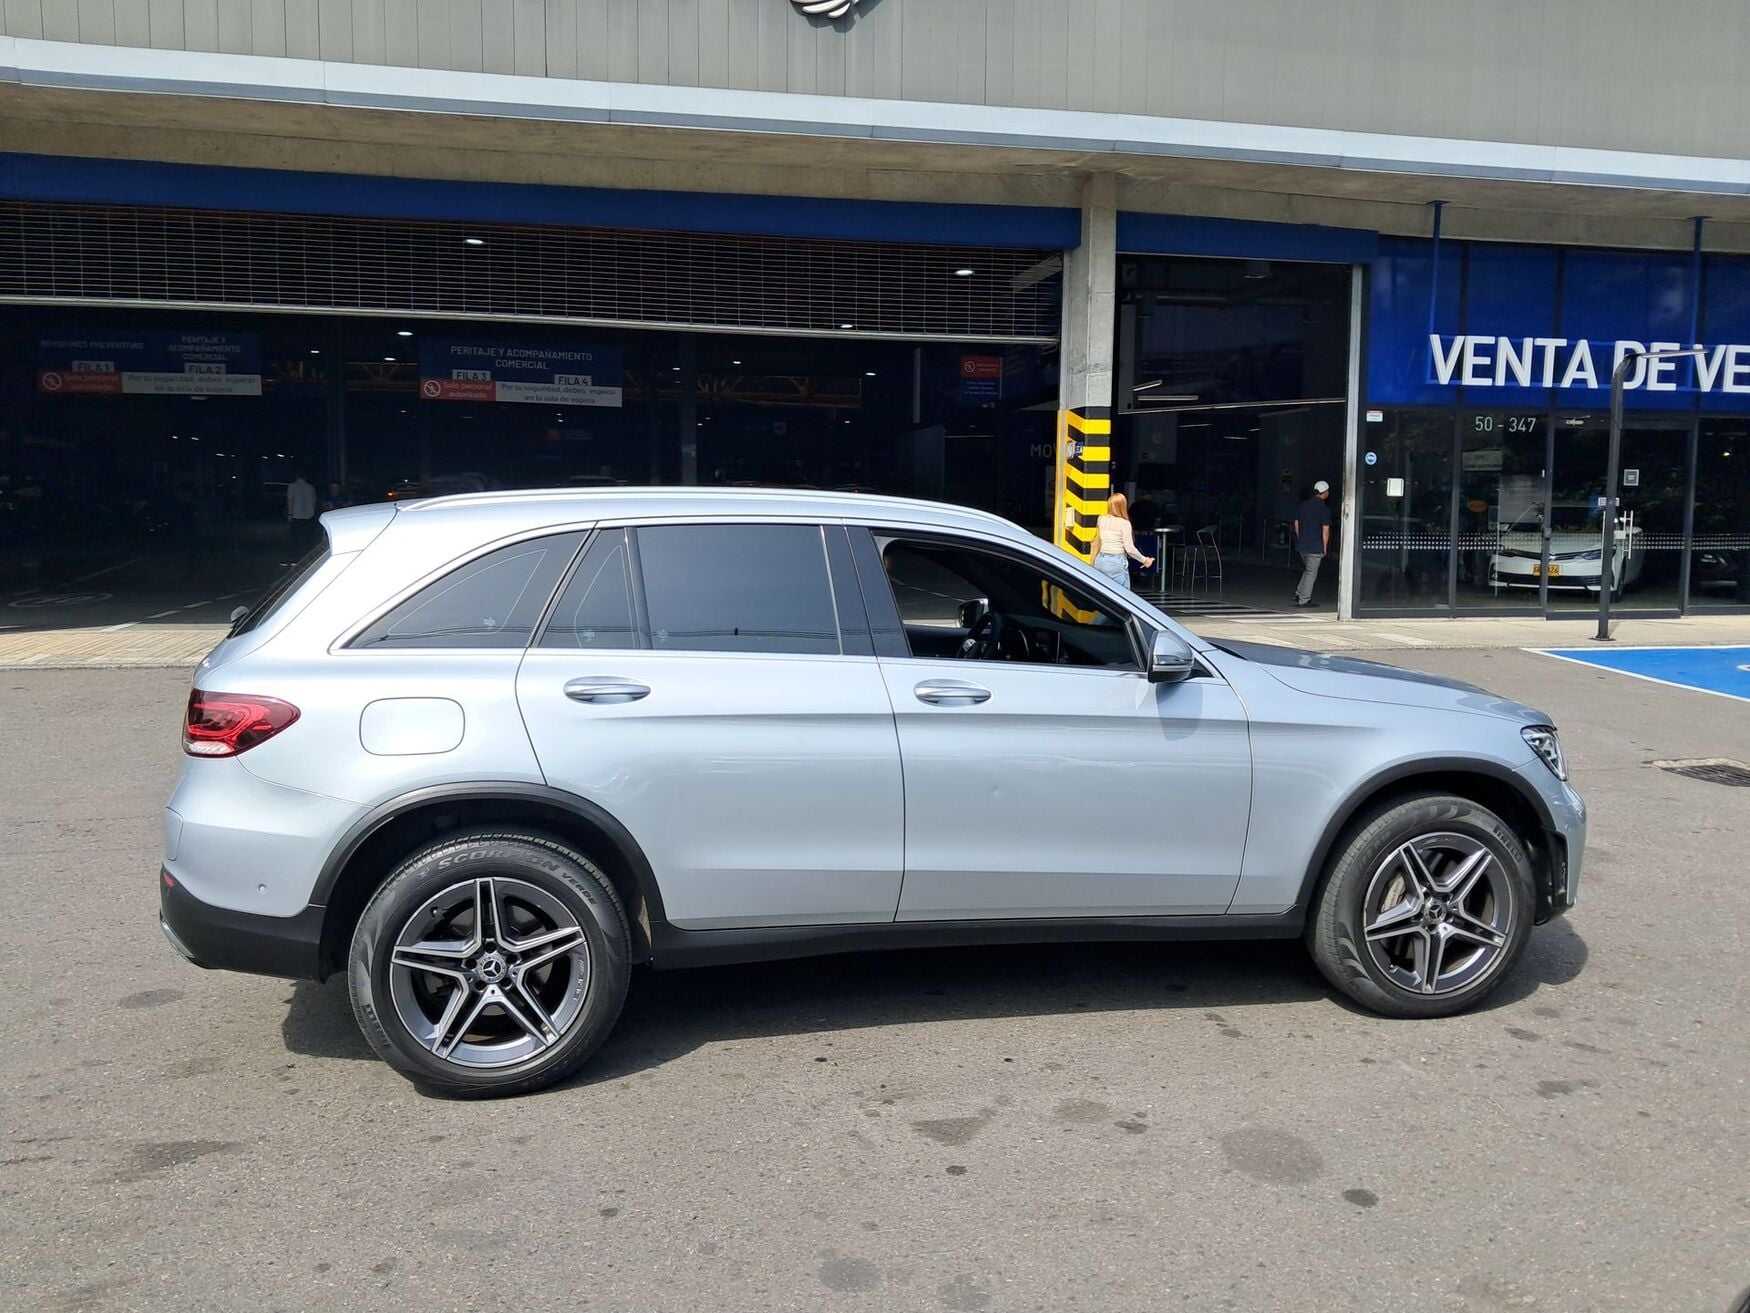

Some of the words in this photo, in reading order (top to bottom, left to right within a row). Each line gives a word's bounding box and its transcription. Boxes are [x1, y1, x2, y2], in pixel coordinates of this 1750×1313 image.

[450, 345, 497, 356] PERITAJE
[498, 347, 505, 357] Y
[506, 347, 593, 361] ACOMPAÑAMIENTO
[79, 362, 101, 372] FILA
[495, 359, 550, 370] COMERCIAL
[1430, 334, 1599, 389] VENTA
[1614, 340, 1681, 391] DE
[1692, 343, 1750, 393] VE
[189, 365, 213, 374] FILA
[456, 371, 479, 380] FILA
[481, 372, 487, 380] 3
[558, 376, 580, 386] FILA
[582, 377, 589, 386] 4
[1474, 416, 1493, 432] 50
[1508, 417, 1537, 433] 347
[438, 849, 562, 872] SCORPION
[560, 871, 598, 905] VERDE
